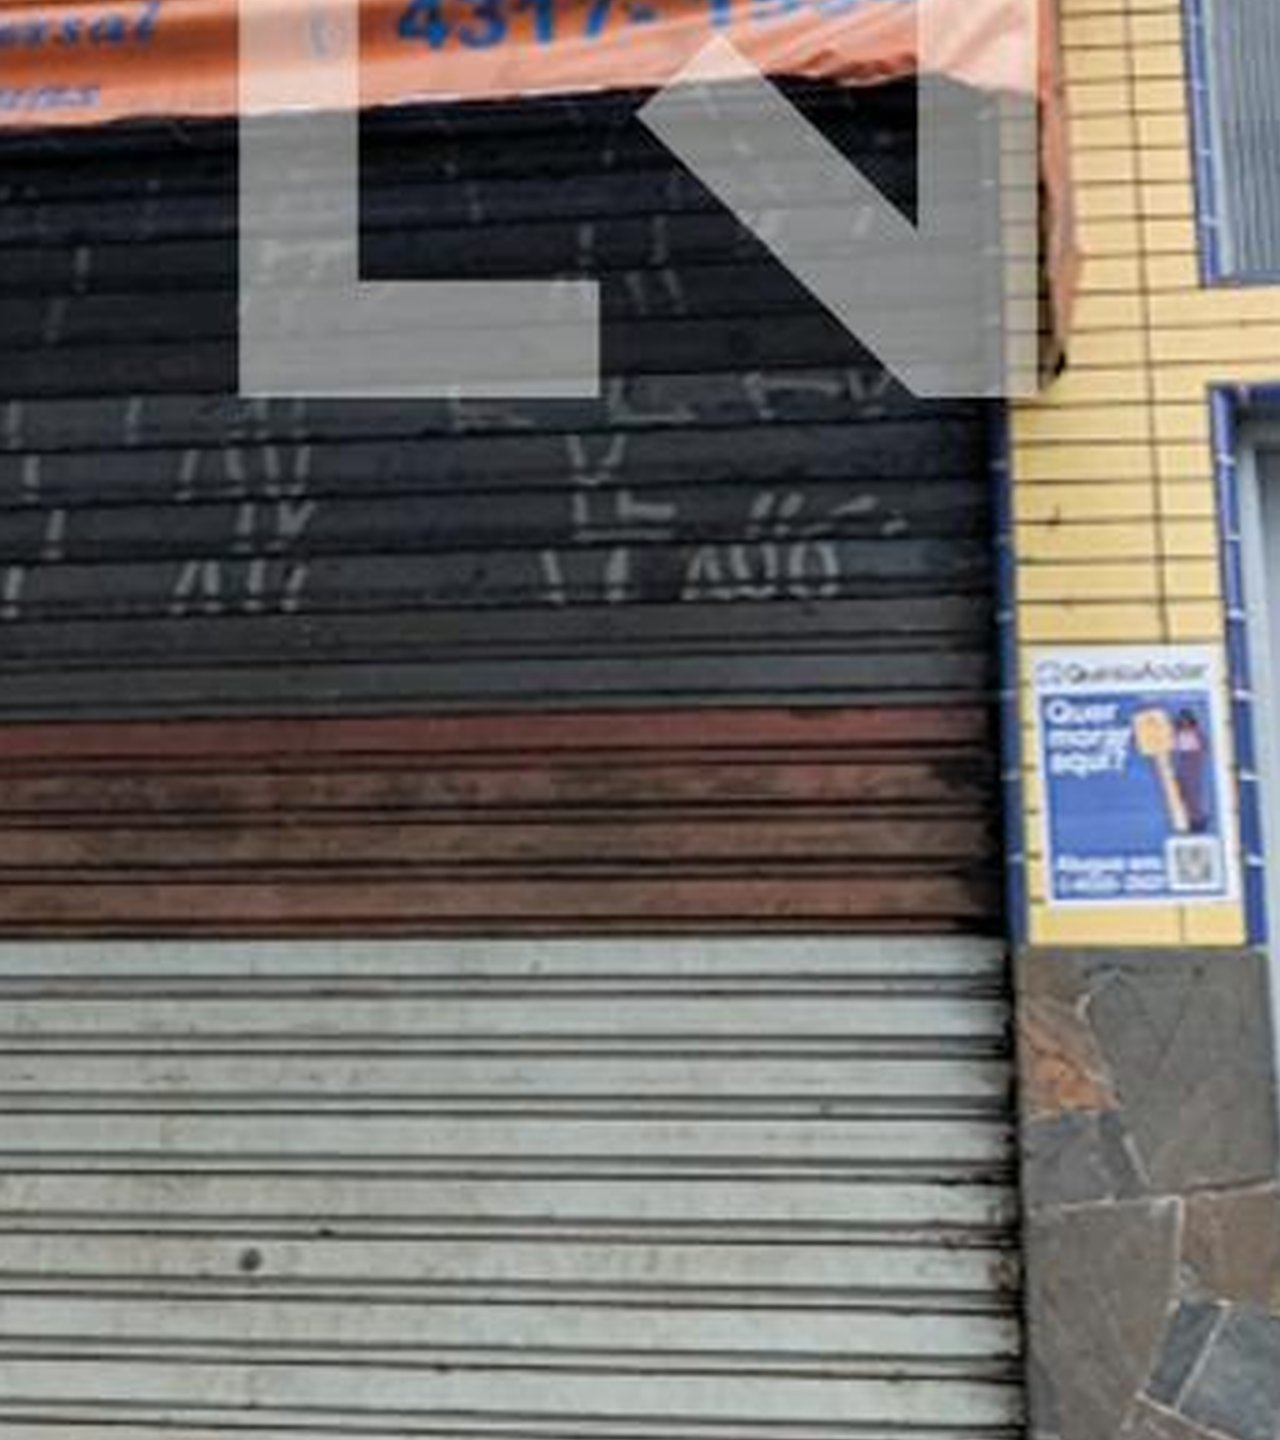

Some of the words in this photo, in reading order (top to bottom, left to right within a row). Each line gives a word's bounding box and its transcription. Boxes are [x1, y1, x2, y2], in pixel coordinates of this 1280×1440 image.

[1046, 698, 1120, 724] Quer
[1048, 727, 1131, 749] morar
[1050, 750, 1126, 777] aqui?
